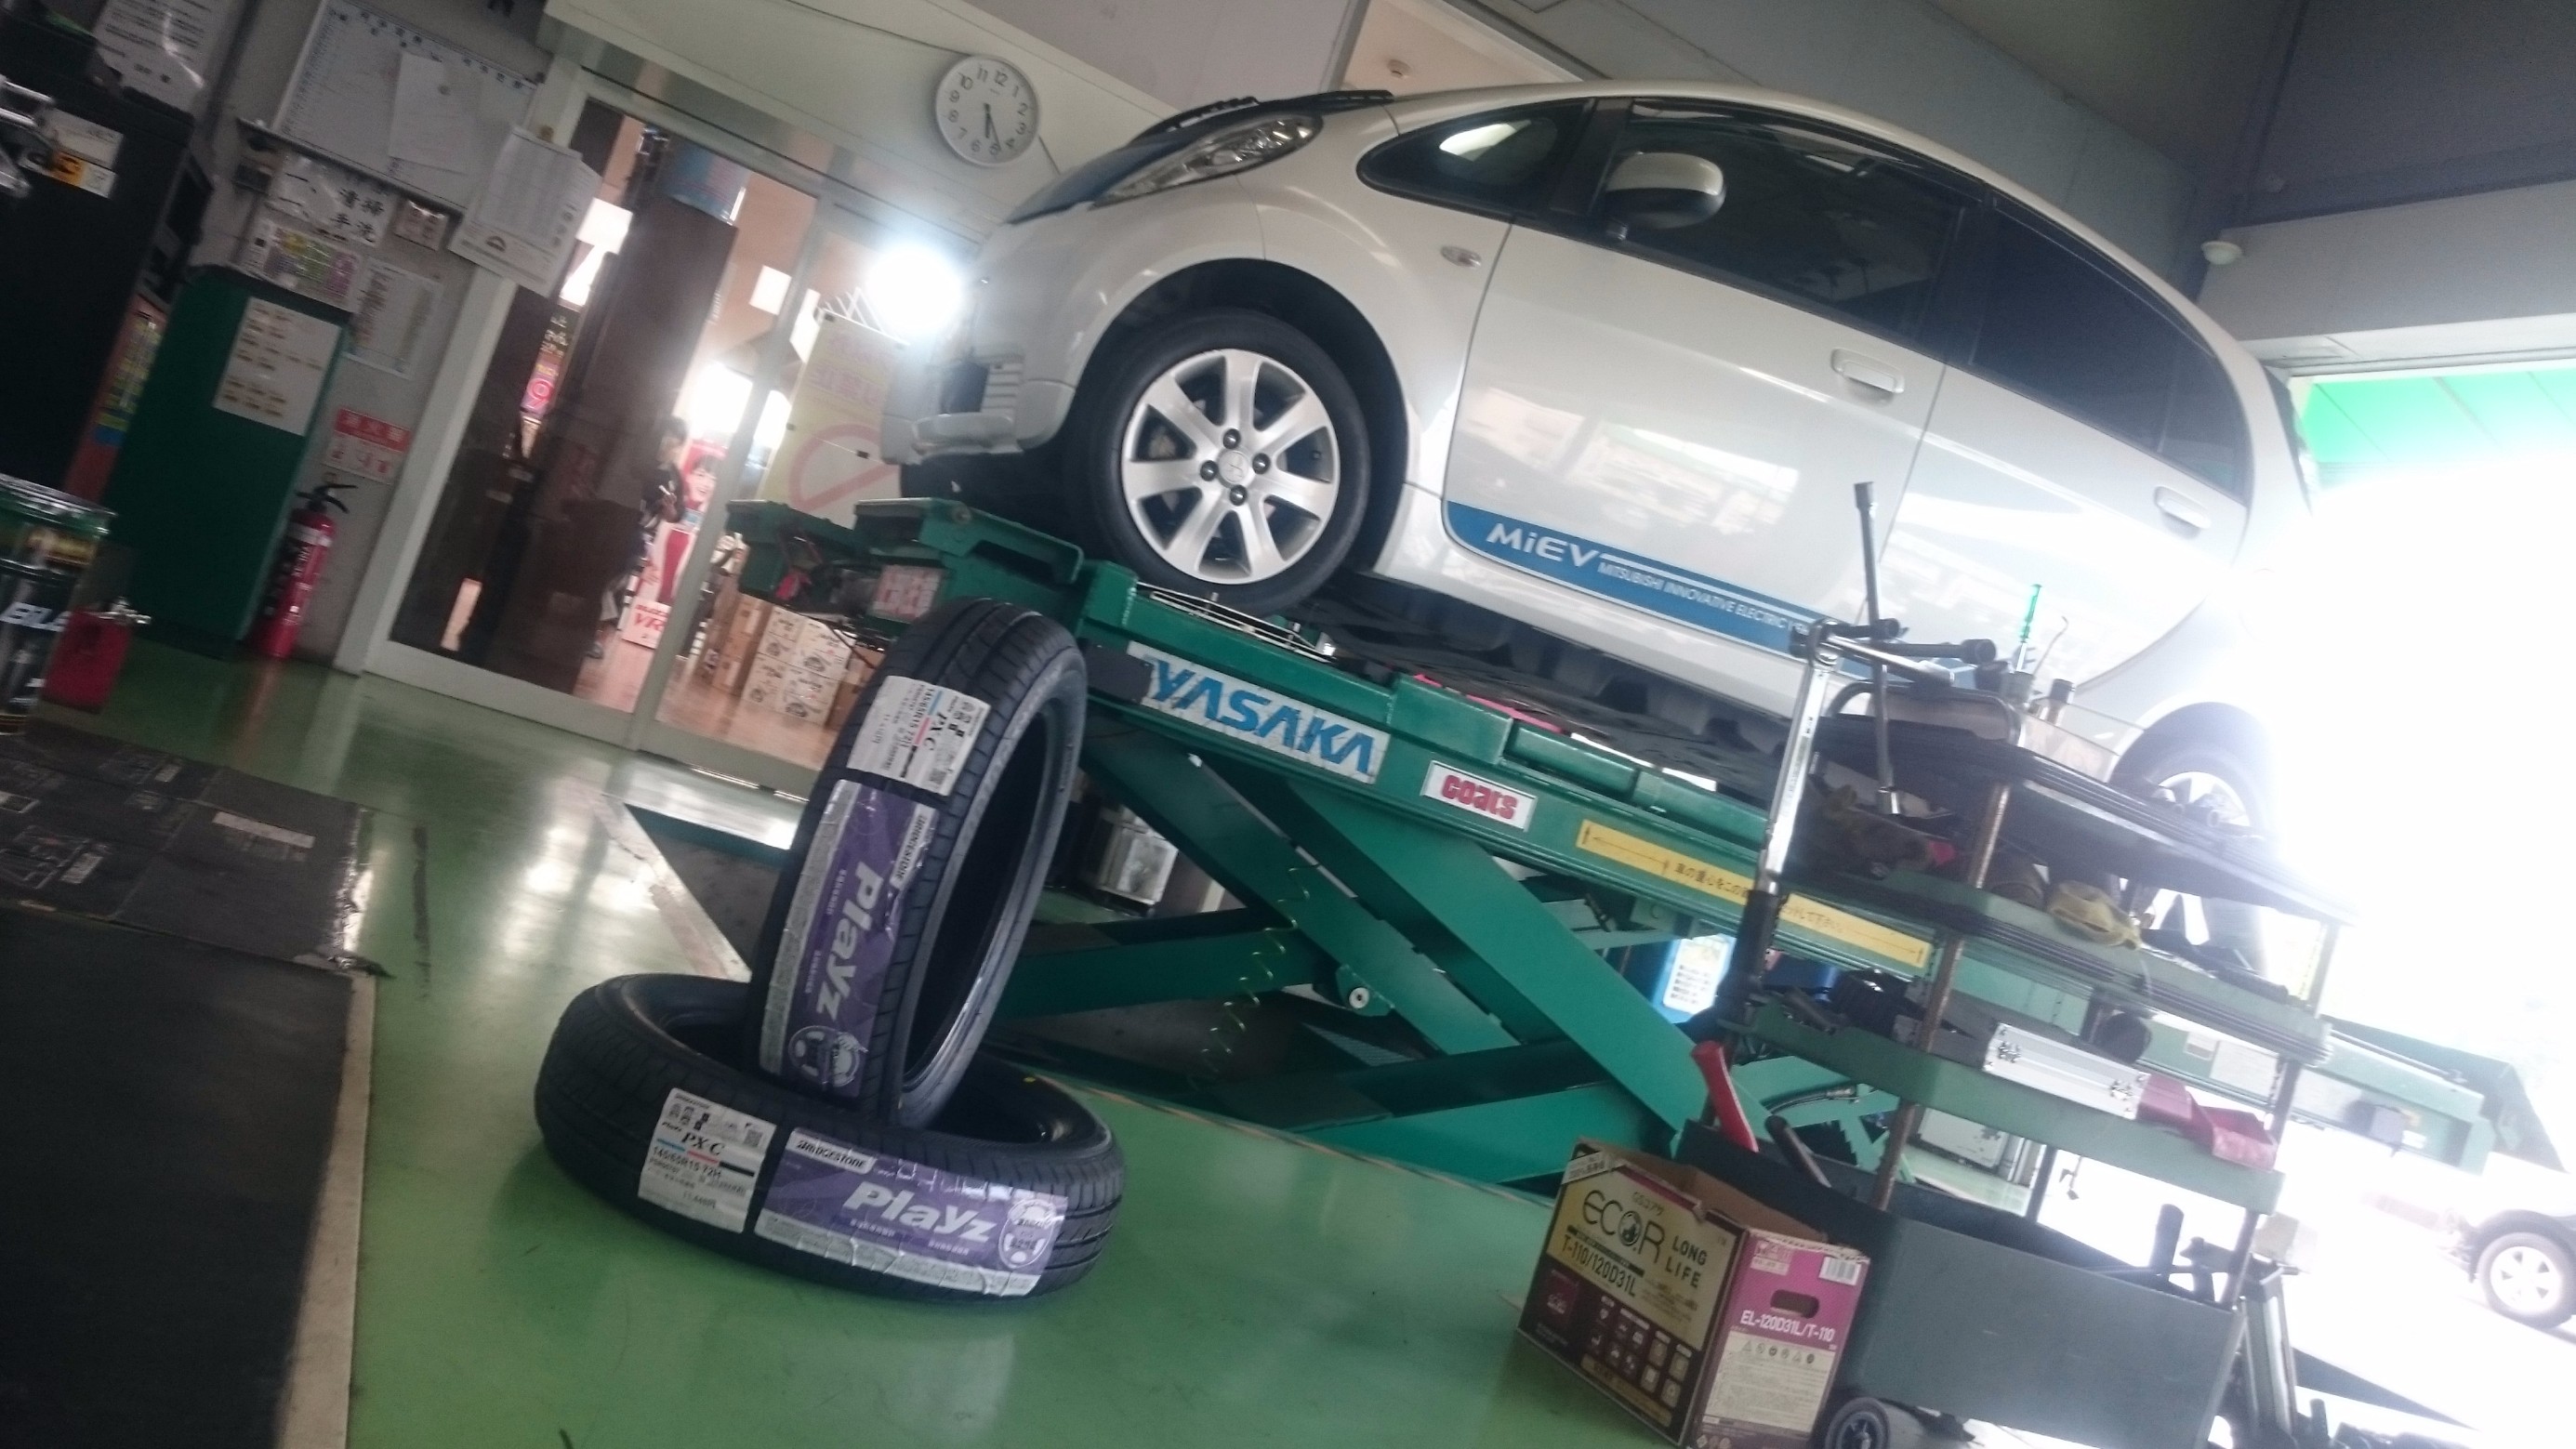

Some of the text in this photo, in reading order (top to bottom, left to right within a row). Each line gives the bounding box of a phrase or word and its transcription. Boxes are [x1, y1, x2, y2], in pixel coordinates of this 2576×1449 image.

[958, 72, 973, 90] 10
[977, 67, 988, 82] 11
[994, 71, 1008, 86] 12
[949, 89, 959, 102] 9
[1017, 102, 1028, 116] 2
[1015, 122, 1026, 135] 3
[1486, 522, 1601, 568] MiEV
[1597, 561, 1663, 591] MITSUBISHI
[1663, 580, 1736, 613] INNOVATIVE
[1735, 601, 1787, 629] ELECTRIC
[1147, 654, 1375, 774] YASAKA
[894, 814, 927, 880] BRIDGESTONE
[815, 861, 884, 1022] Playz
[796, 1138, 866, 1169] BRIDGESTONE
[842, 1179, 997, 1244] Playz
[1561, 1233, 1637, 1298] T-110/120D31L
[1671, 1235, 1708, 1267] LONG
[1665, 1256, 1702, 1289] LIFE
[1739, 1309, 1837, 1343] EL-120D31L/T-110
